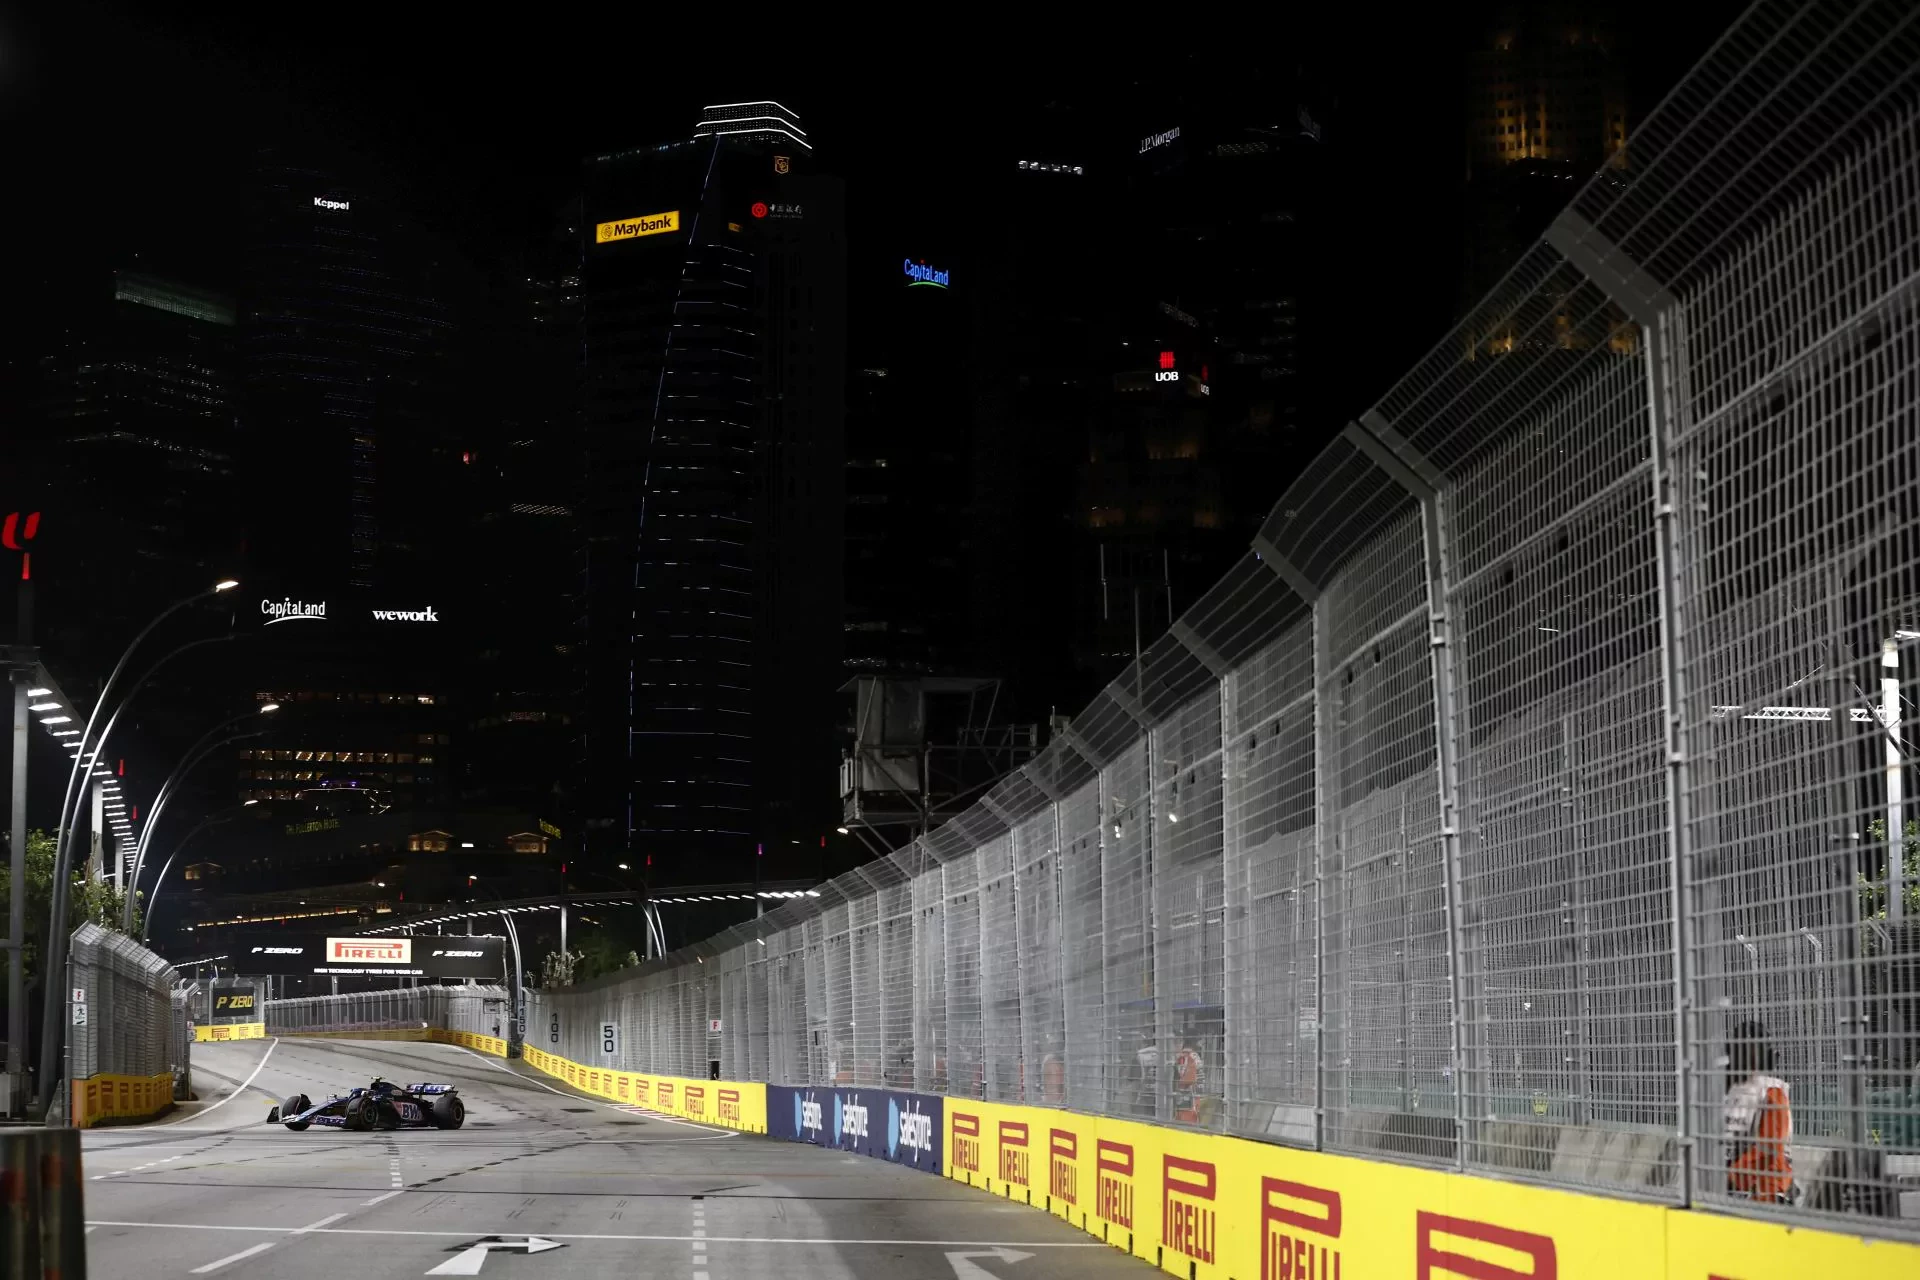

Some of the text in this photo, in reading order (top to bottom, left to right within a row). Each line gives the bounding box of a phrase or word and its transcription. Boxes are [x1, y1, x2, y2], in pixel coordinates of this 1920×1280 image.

[614, 215, 671, 236] Maybank
[904, 257, 949, 286] CapitaLand
[1155, 371, 1179, 382] UOB
[261, 596, 326, 618] CapitaLand
[372, 605, 440, 622] wework
[263, 947, 304, 955] ZERO
[335, 942, 403, 959] PIRELLI
[216, 995, 254, 1009] P ZERO
[551, 1012, 559, 1043] 100
[603, 1025, 615, 1053] 50
[713, 1021, 719, 1030] F
[657, 1082, 674, 1108] PIRELLI
[685, 1085, 705, 1115] PIRELLI
[718, 1089, 740, 1121] PIRELLI
[802, 1091, 823, 1139] salesforce
[842, 1093, 868, 1148] salesforce
[899, 1099, 932, 1162] salesforce
[951, 1111, 980, 1173] PIRELLI
[998, 1120, 1029, 1187] PIRELLI
[1049, 1127, 1077, 1206] PIRELLI
[1096, 1138, 1135, 1231] PIRELLI
[1161, 1153, 1217, 1266] PIRELLI
